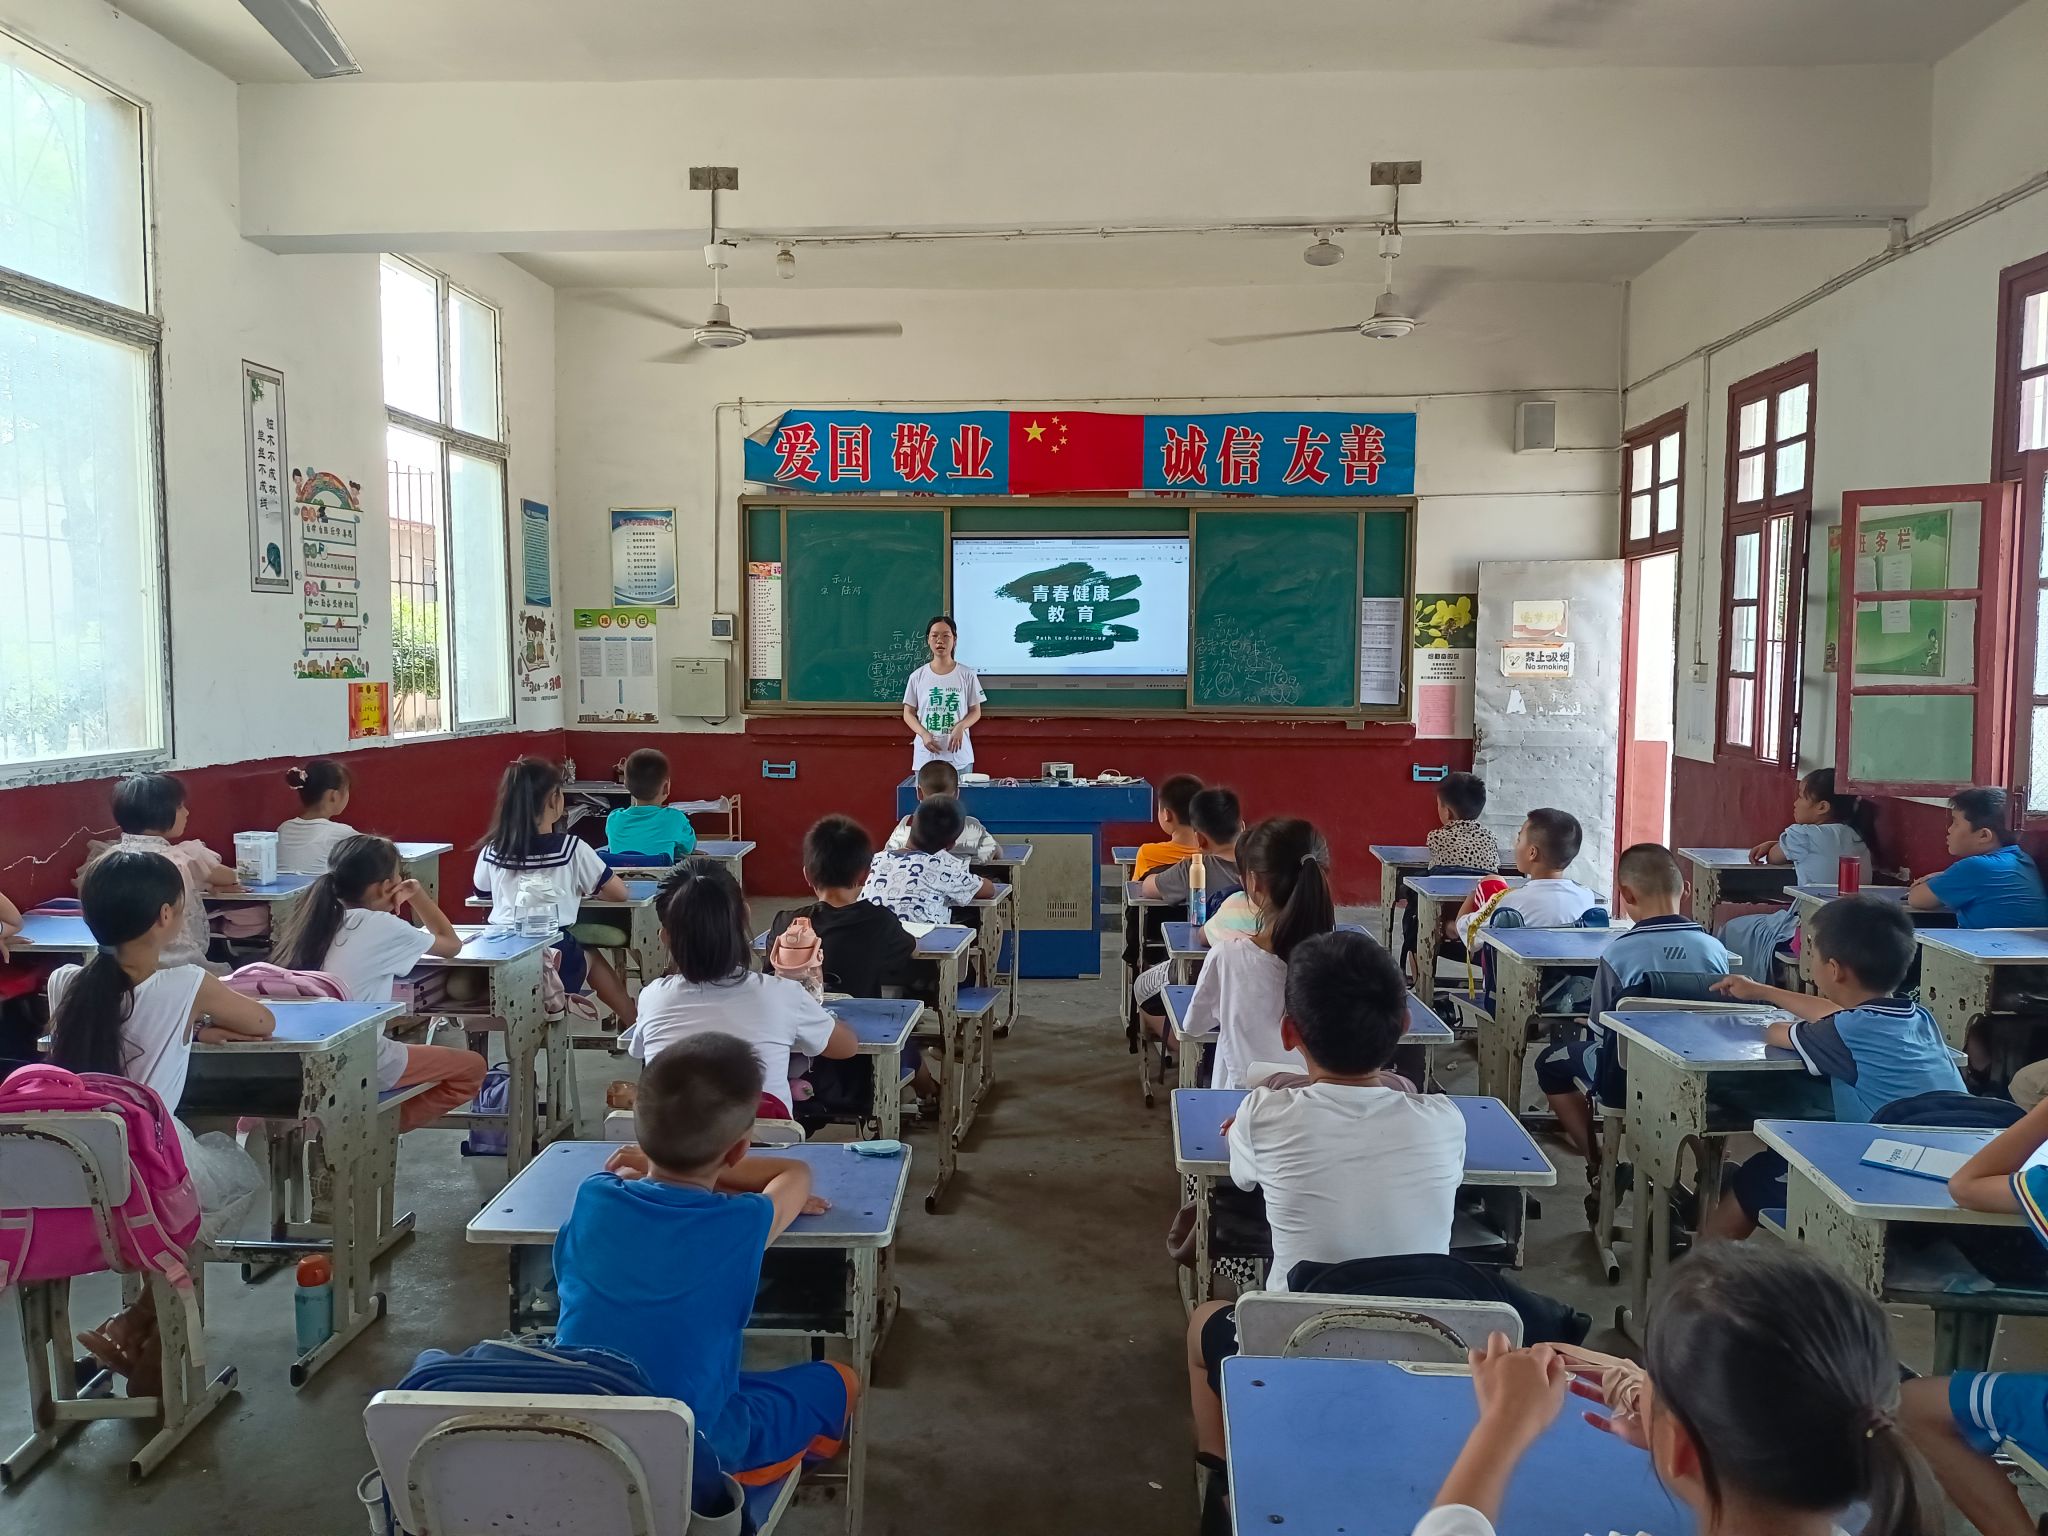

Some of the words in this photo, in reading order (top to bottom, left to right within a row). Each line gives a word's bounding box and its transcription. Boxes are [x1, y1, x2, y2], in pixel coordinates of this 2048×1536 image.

[774, 422, 872, 483] 爱国
[892, 422, 994, 483] 敬业
[1161, 424, 1264, 486] 诚信
[1282, 424, 1386, 485] 友善
[1032, 585, 1110, 602] 青春健康
[1048, 605, 1095, 623] 教育
[1525, 651, 1570, 663] 禁止吸烟
[1537, 663, 1568, 671] smoking
[926, 712, 955, 731] 健康
